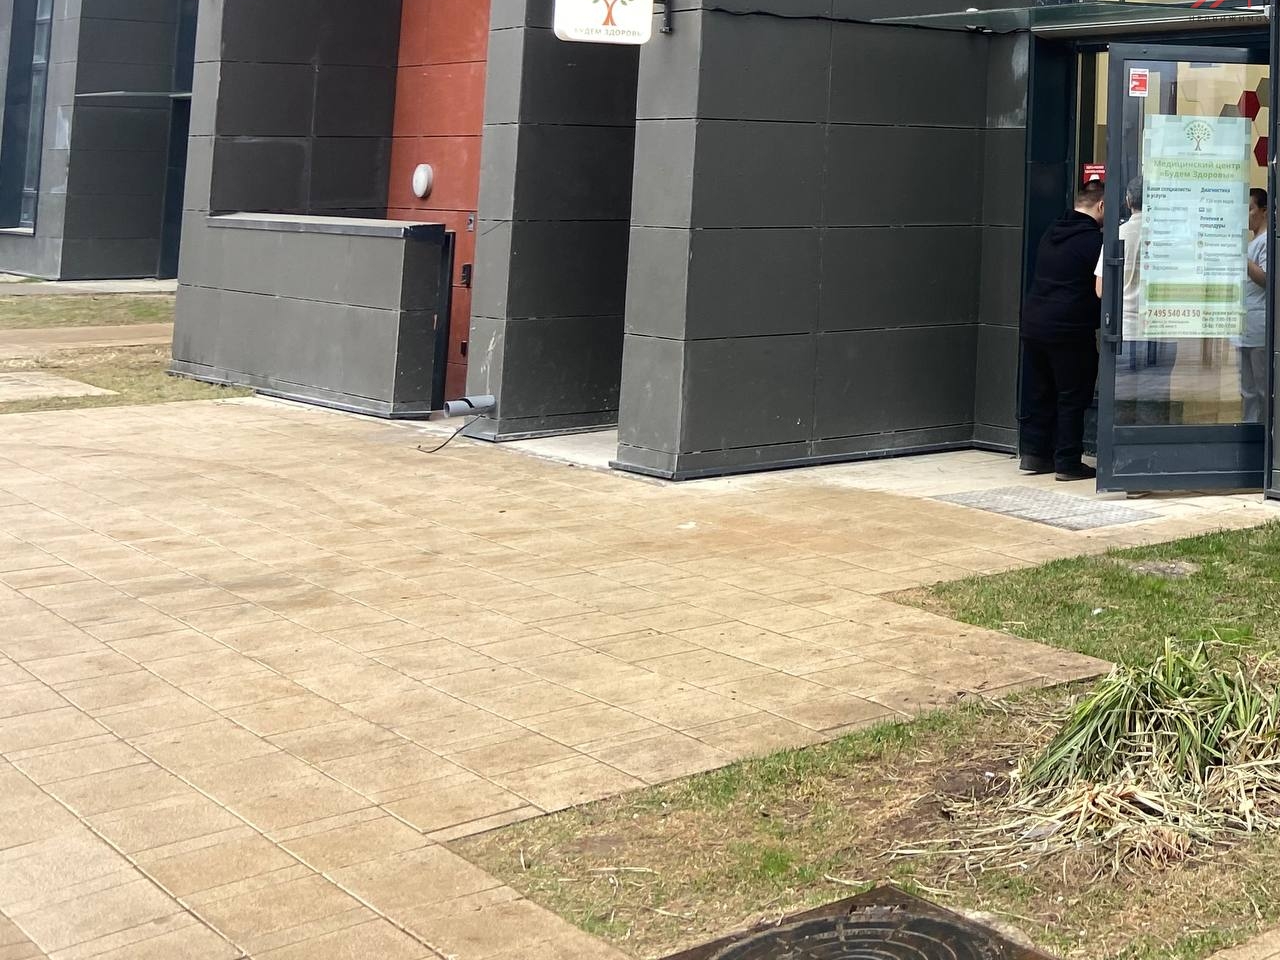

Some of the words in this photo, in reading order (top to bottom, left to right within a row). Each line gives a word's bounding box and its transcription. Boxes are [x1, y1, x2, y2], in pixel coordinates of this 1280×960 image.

[1153, 160, 1214, 170] Медицинский
[1215, 162, 1241, 171] центр
[1153, 309, 1167, 318] 495
[1167, 309, 1181, 318] 540
[1182, 309, 1191, 318] 43
[1191, 309, 1201, 318] 50
